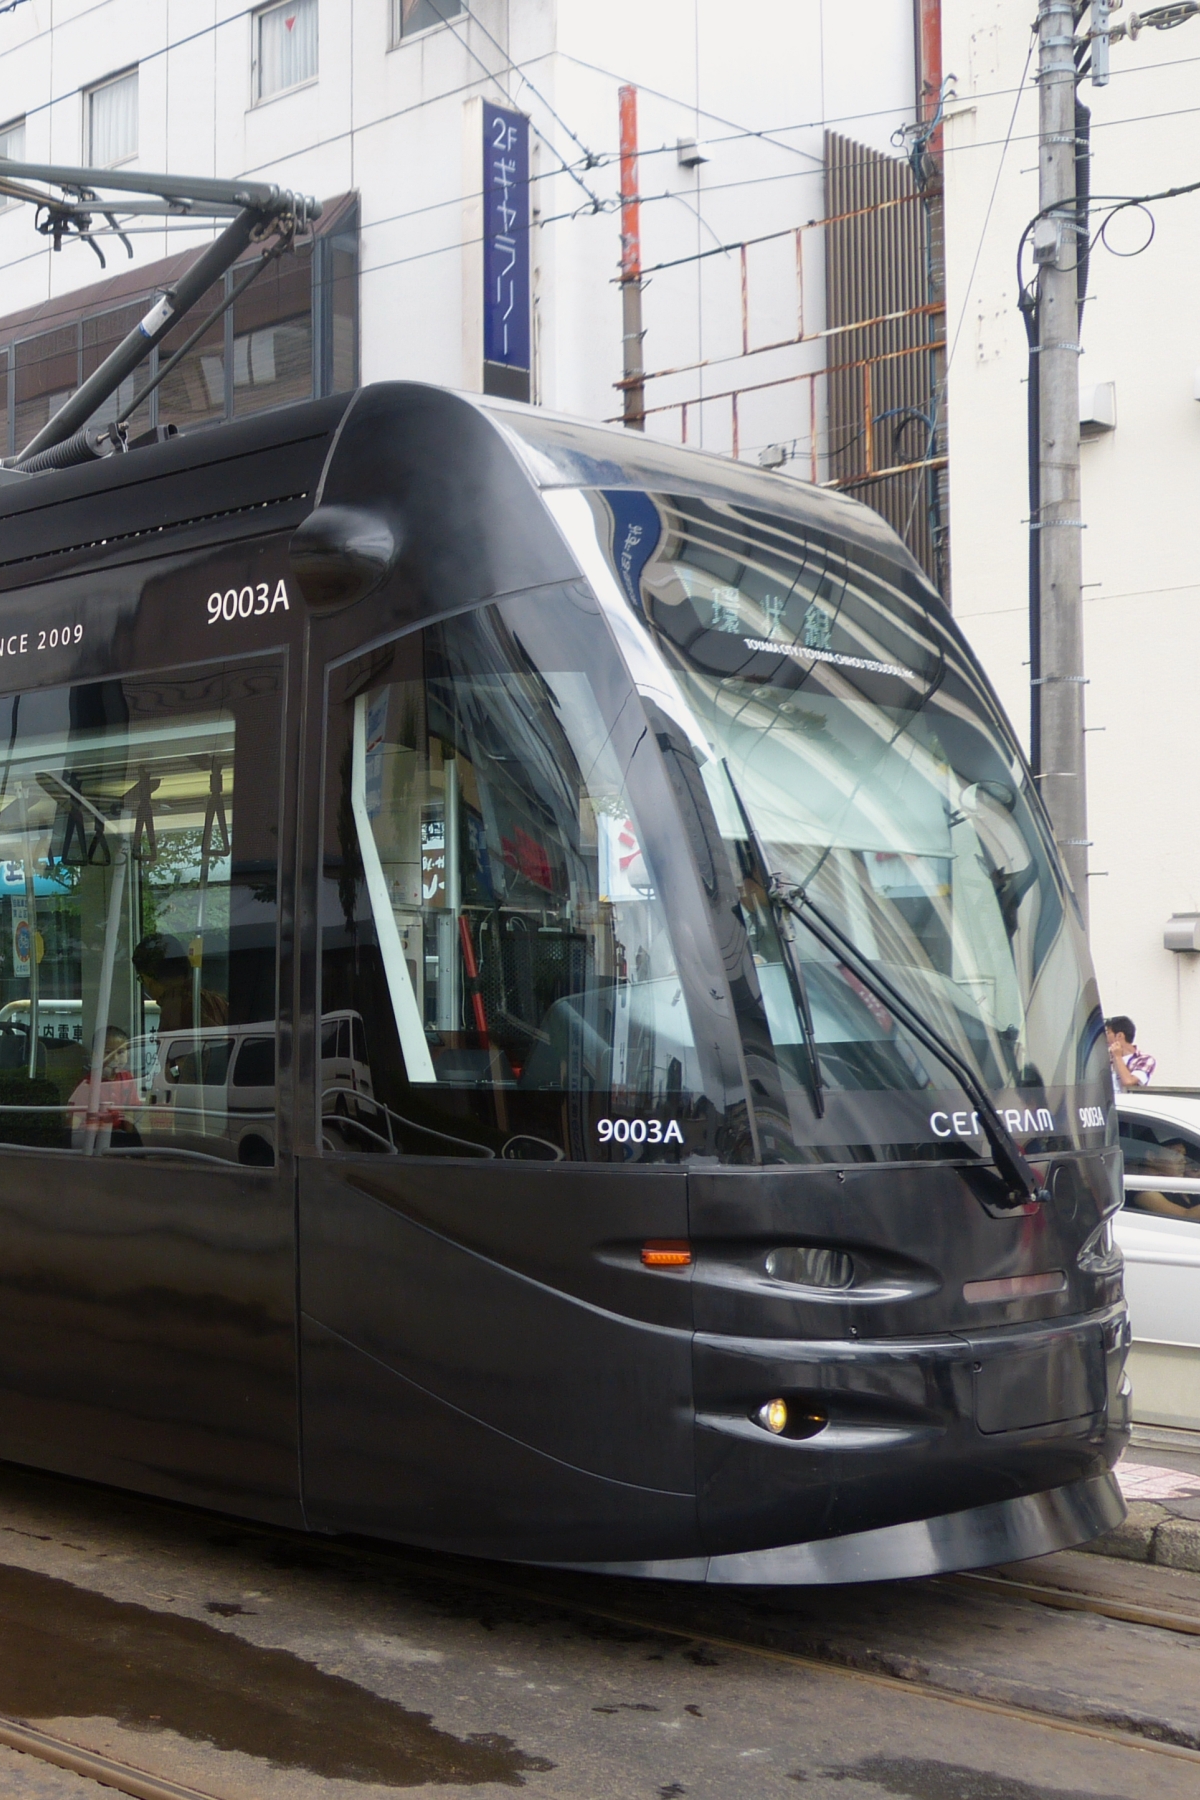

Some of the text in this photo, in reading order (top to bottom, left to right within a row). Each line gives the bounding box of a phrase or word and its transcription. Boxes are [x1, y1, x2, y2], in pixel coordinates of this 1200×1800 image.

[492, 117, 518, 356] 2F ギャラリー
[206, 579, 290, 625] 9003A
[38, 624, 84, 651] 2009
[744, 638, 779, 654] TOYAMA
[802, 648, 834, 663] TOYAMA
[37, 1023, 83, 1042] 内電車
[930, 1108, 1054, 1137] CERAM
[1079, 1107, 1105, 1128] 9003A
[597, 1119, 684, 1143] 9003A
